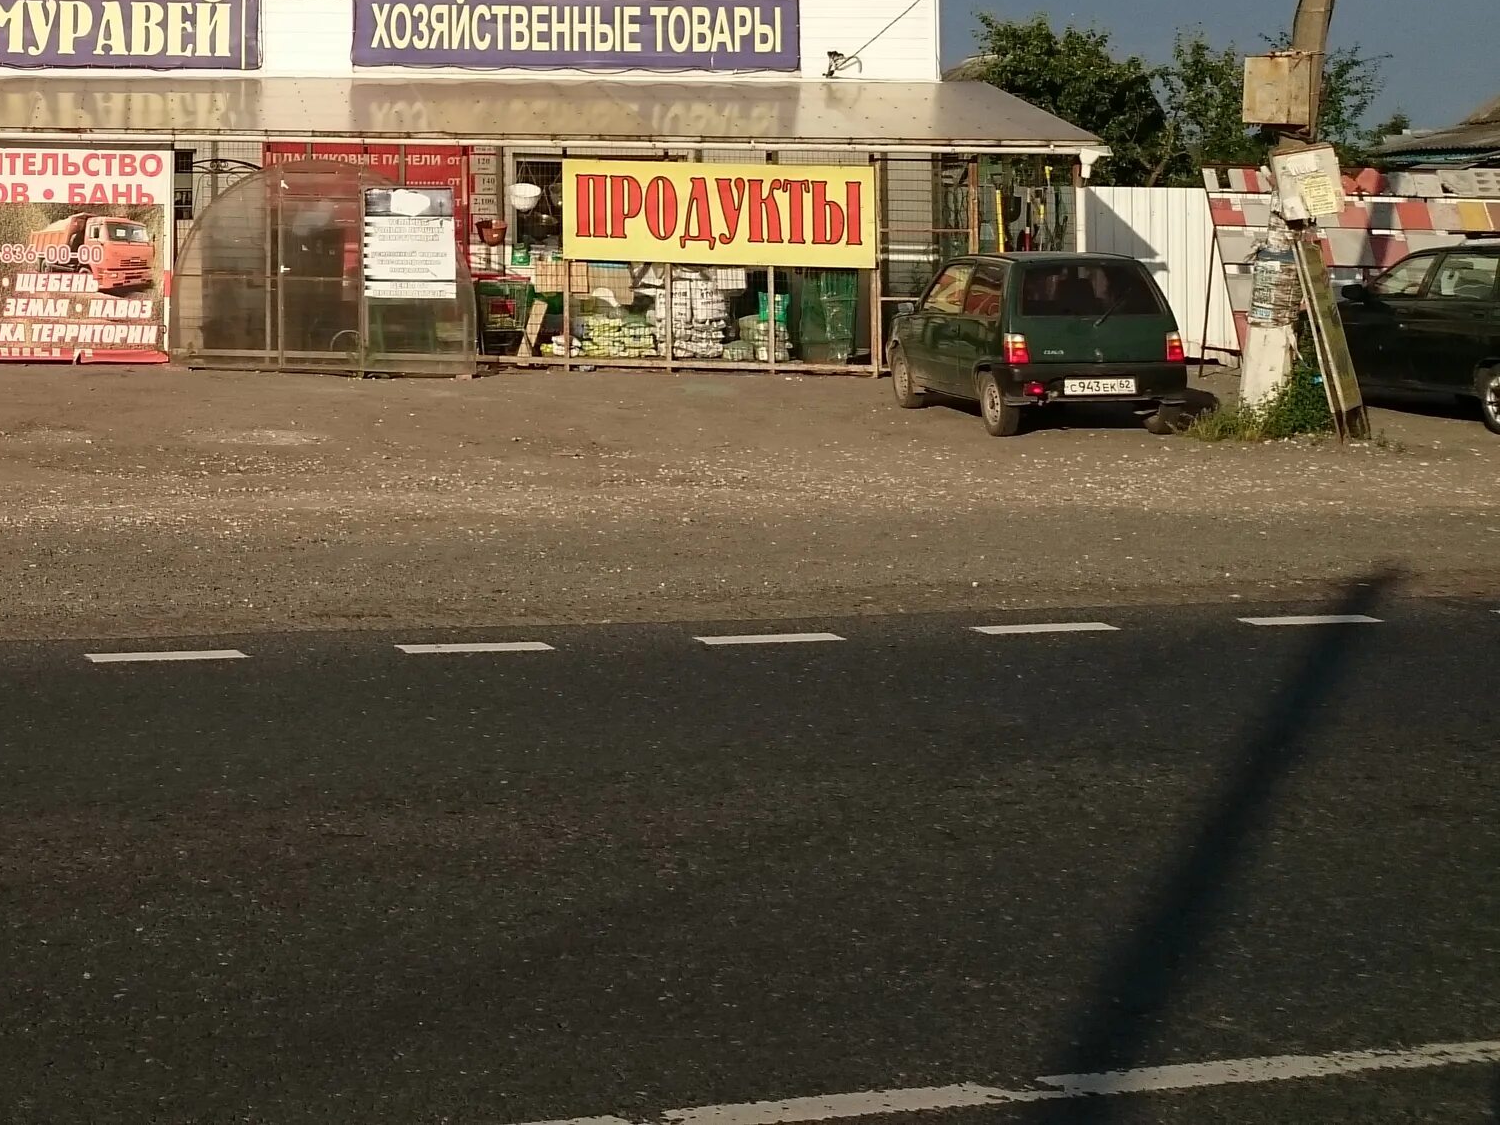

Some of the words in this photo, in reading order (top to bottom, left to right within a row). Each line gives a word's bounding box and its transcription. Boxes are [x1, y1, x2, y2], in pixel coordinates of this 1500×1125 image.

[649, 5, 782, 54] ТОВАРЫ
[382, 156, 441, 166] ПАНЕЛИ
[68, 183, 155, 204] БАНЬ
[575, 173, 863, 250] ПРОДУКТЫ
[15, 274, 99, 293] ЩЕБЕНЬ
[3, 299, 70, 317] ЗЕМЛЯ
[88, 300, 153, 319] НАВОЗ
[31, 324, 157, 344] ТЕРРИТОРИИ
